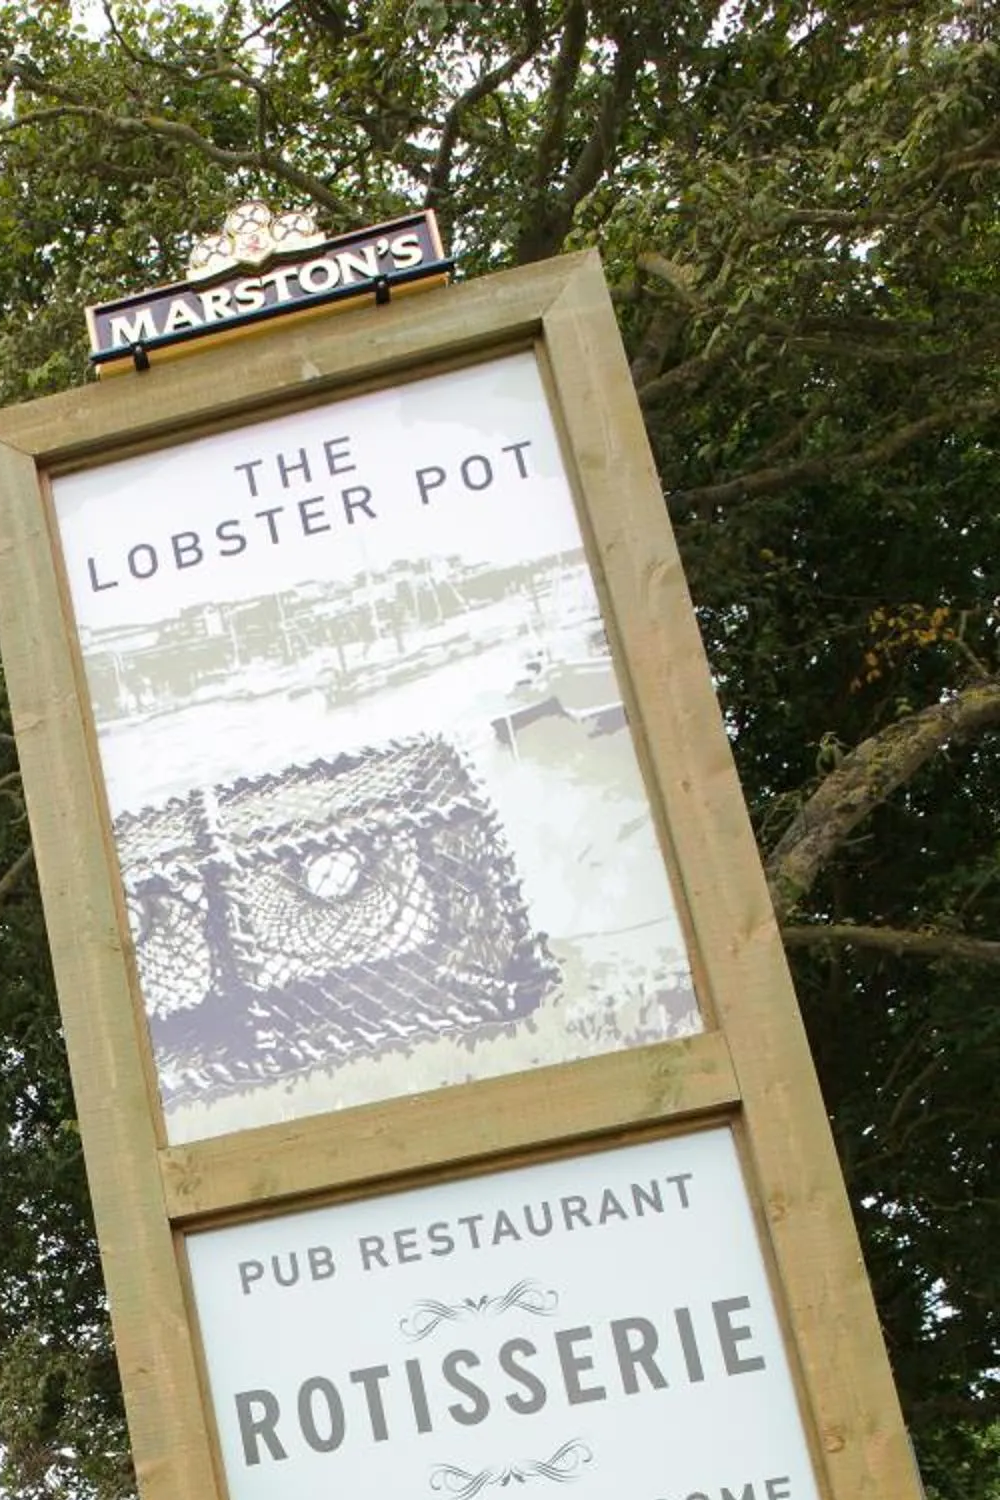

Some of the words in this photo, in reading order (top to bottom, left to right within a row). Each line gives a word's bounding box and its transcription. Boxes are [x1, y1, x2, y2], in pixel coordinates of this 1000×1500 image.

[110, 234, 423, 348] MARSTON'S
[87, 486, 377, 592] LOBSTER
[415, 441, 533, 505] POT
[235, 436, 357, 497] THE
[238, 1246, 336, 1294] PUB
[359, 1173, 693, 1270] RESTAURANT
[235, 1295, 766, 1466] ROTISSERIE
